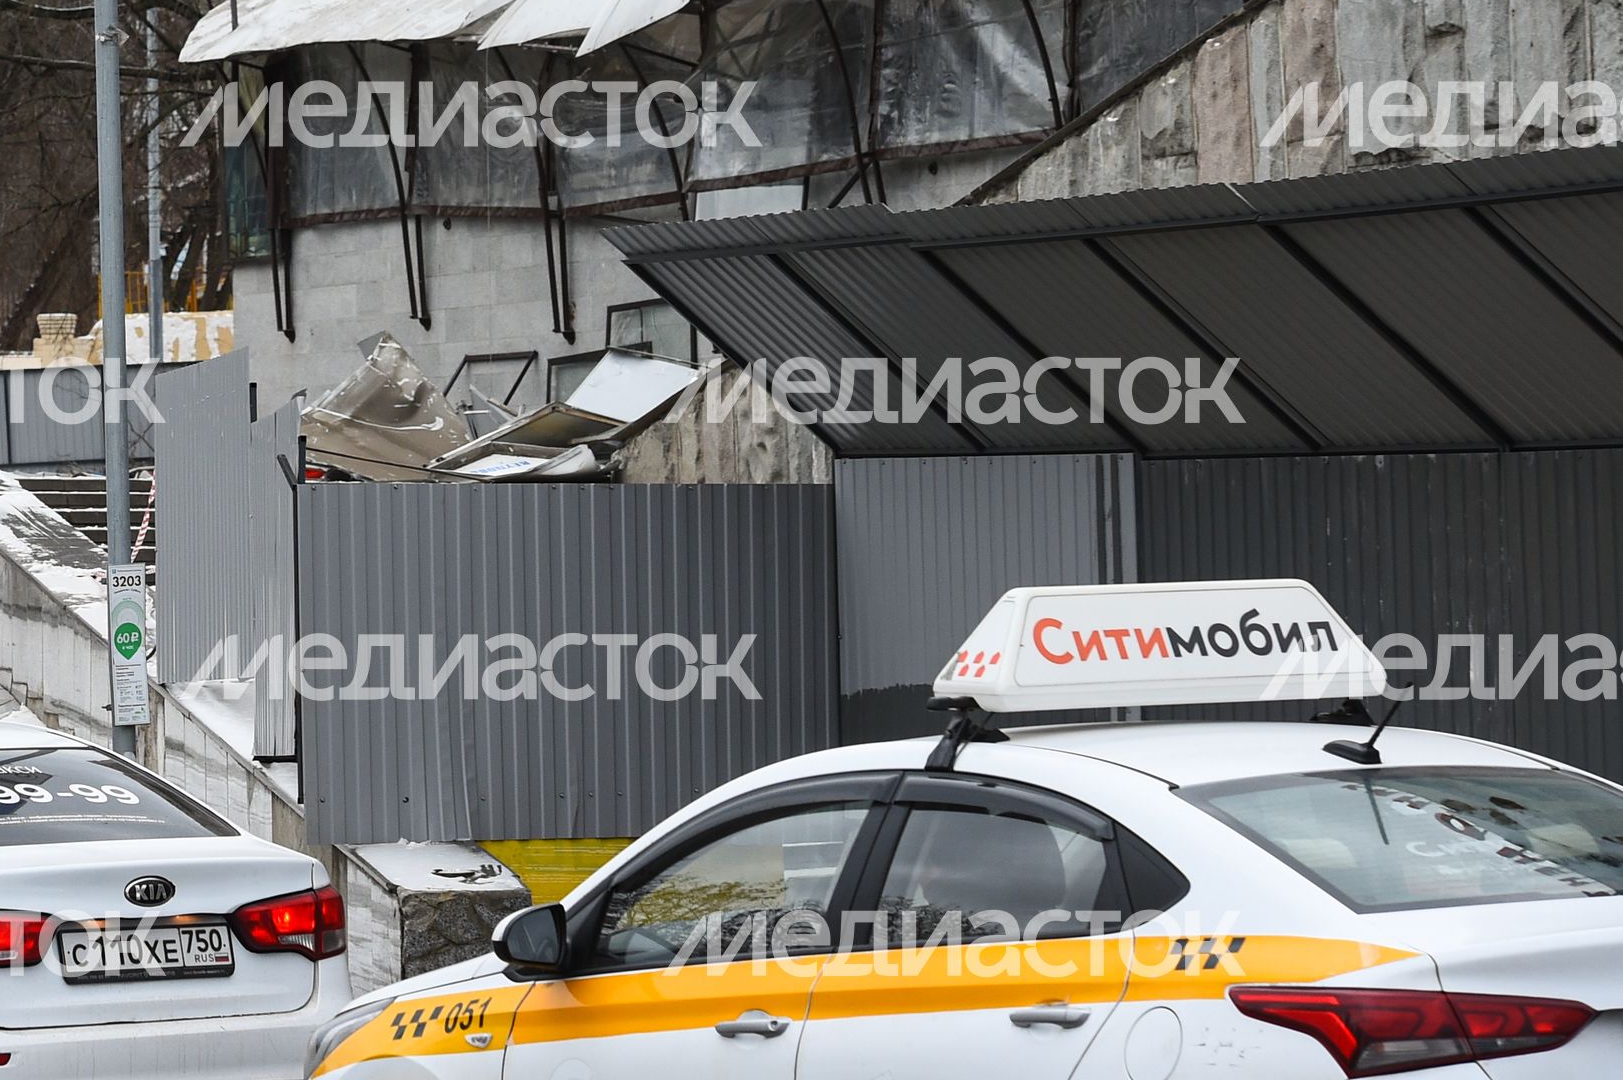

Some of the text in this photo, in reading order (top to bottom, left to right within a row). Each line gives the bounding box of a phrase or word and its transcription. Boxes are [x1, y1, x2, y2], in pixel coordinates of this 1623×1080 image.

[112, 575, 141, 587] 3203
[117, 633, 129, 644] 60
[1033, 608, 1339, 665] Ситимобил
[135, 884, 168, 901] KIA
[181, 928, 222, 953] 750
[194, 953, 214, 963] RUS
[444, 996, 493, 1033] 051
